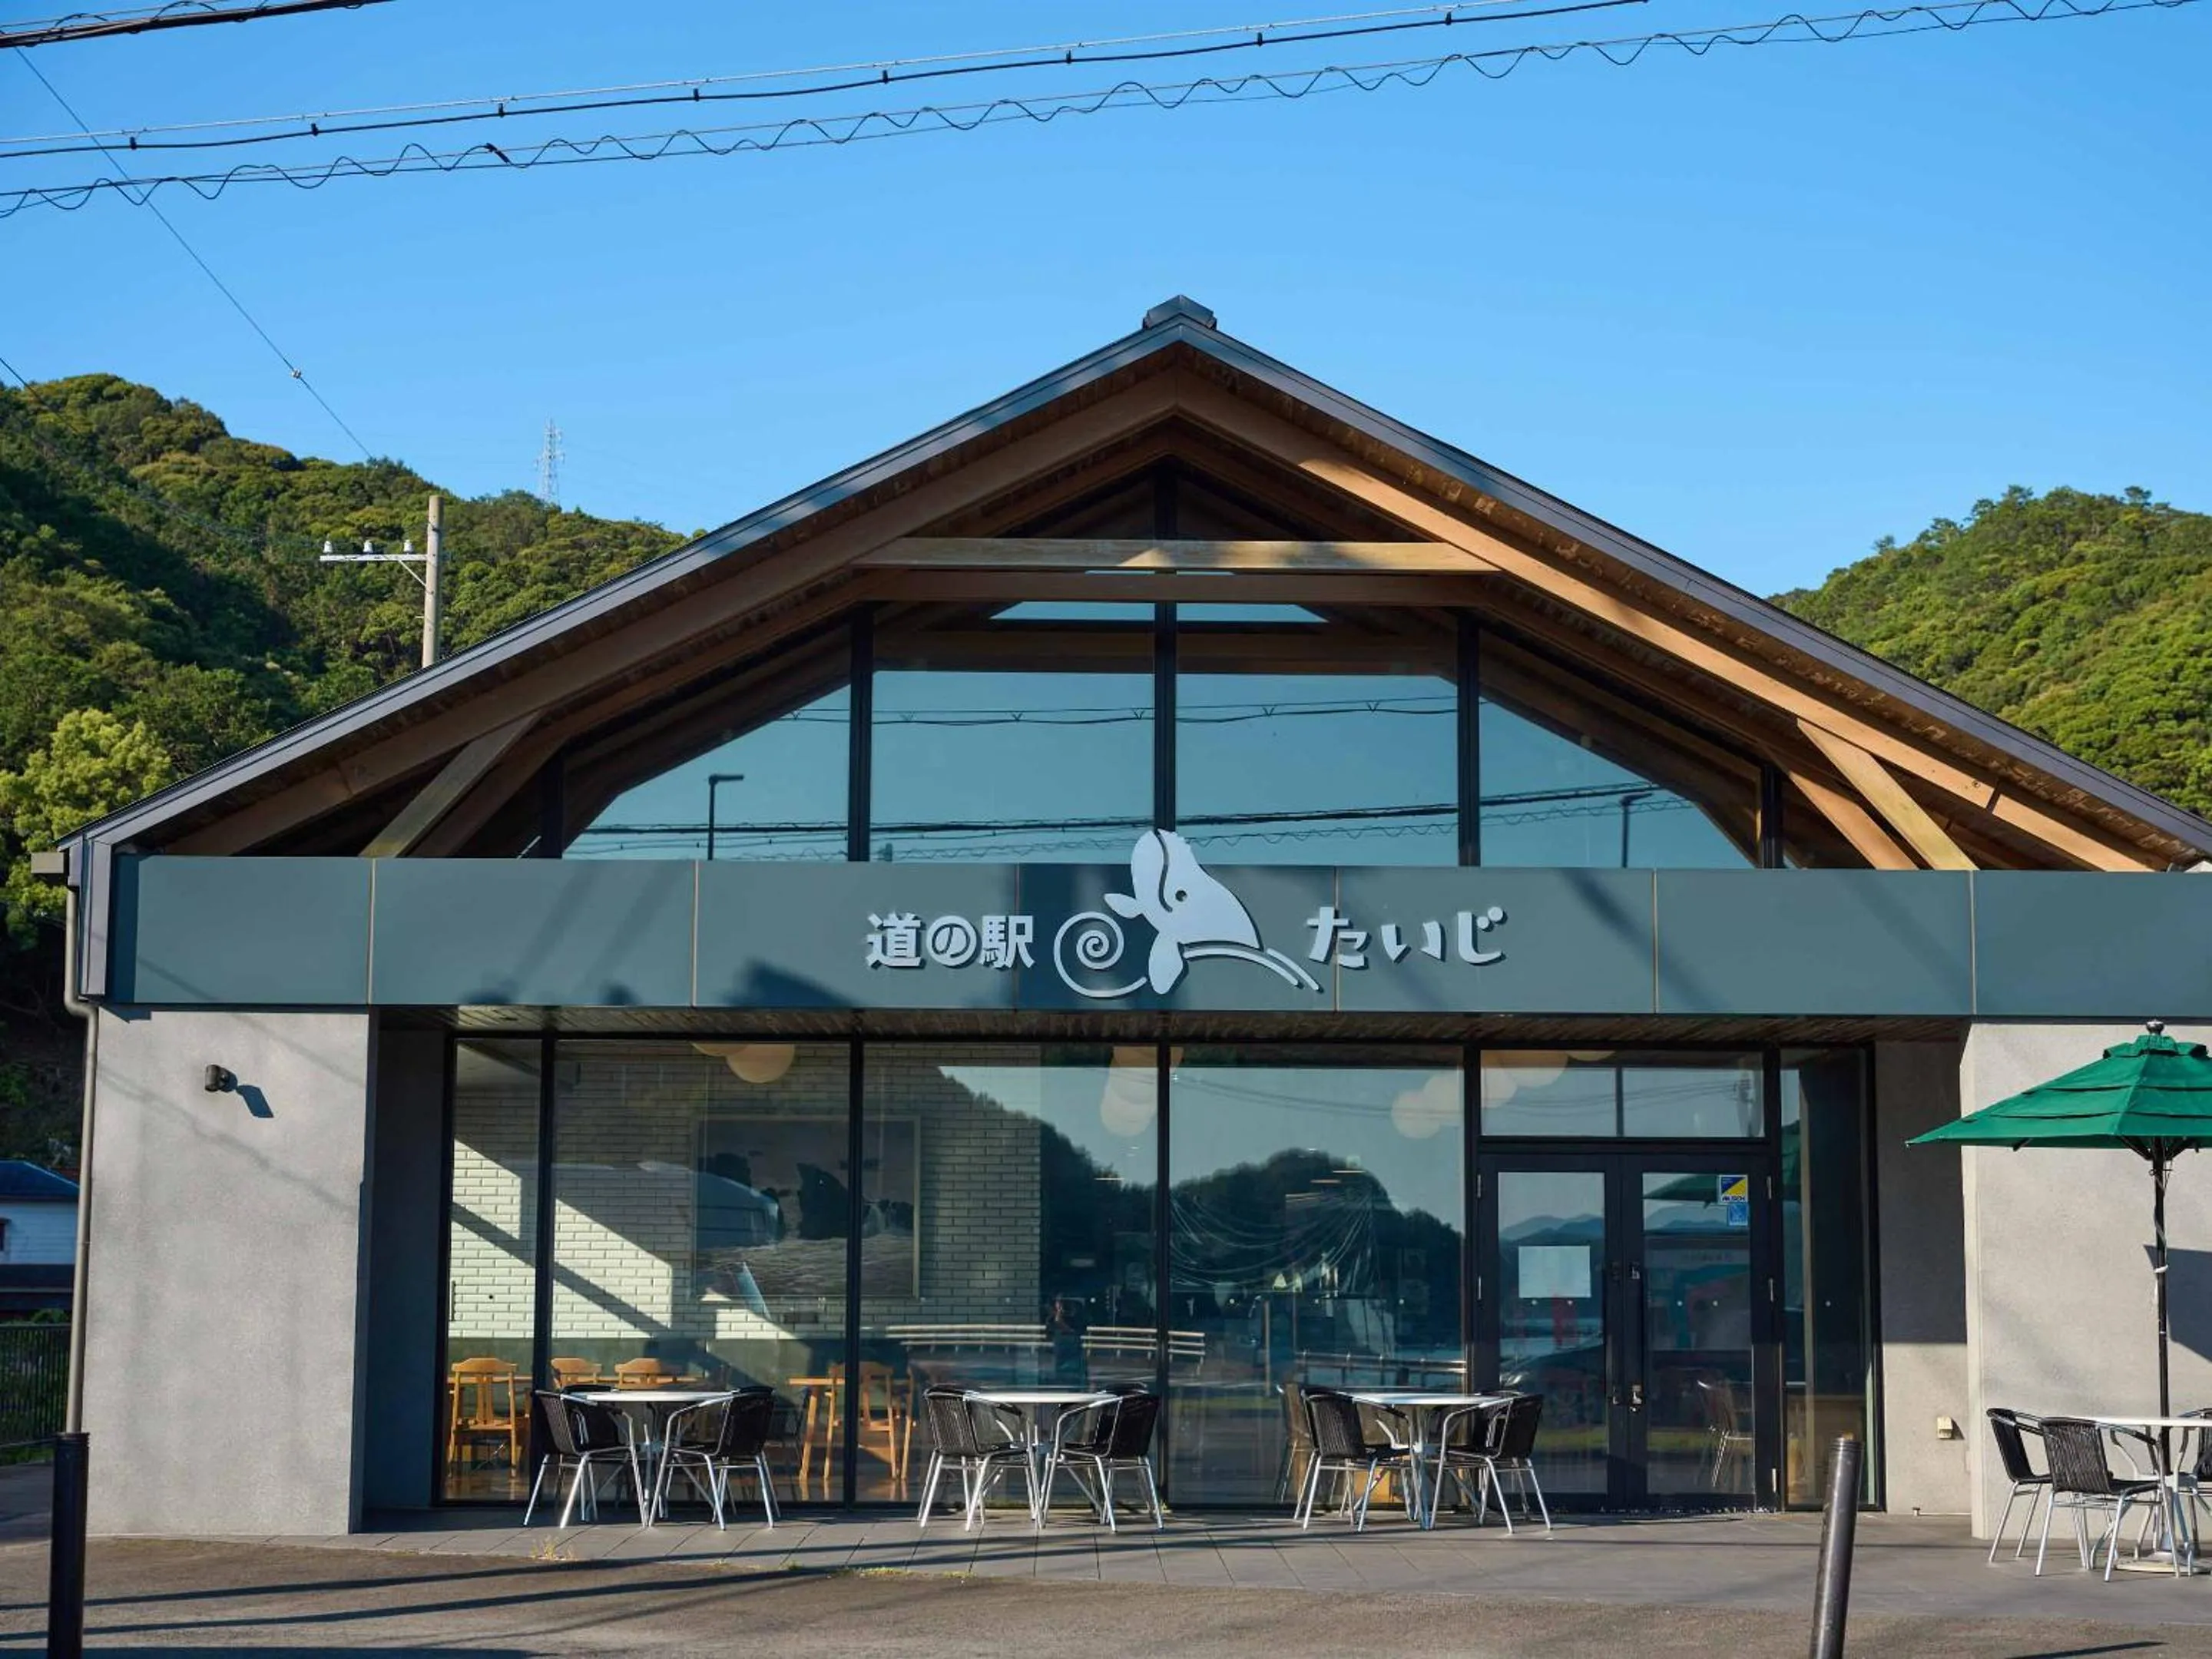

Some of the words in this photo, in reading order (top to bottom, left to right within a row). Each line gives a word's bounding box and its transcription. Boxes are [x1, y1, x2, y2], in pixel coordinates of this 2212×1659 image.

[866, 912, 1034, 968] 道の駅
[1307, 906, 1503, 968] たいじ
